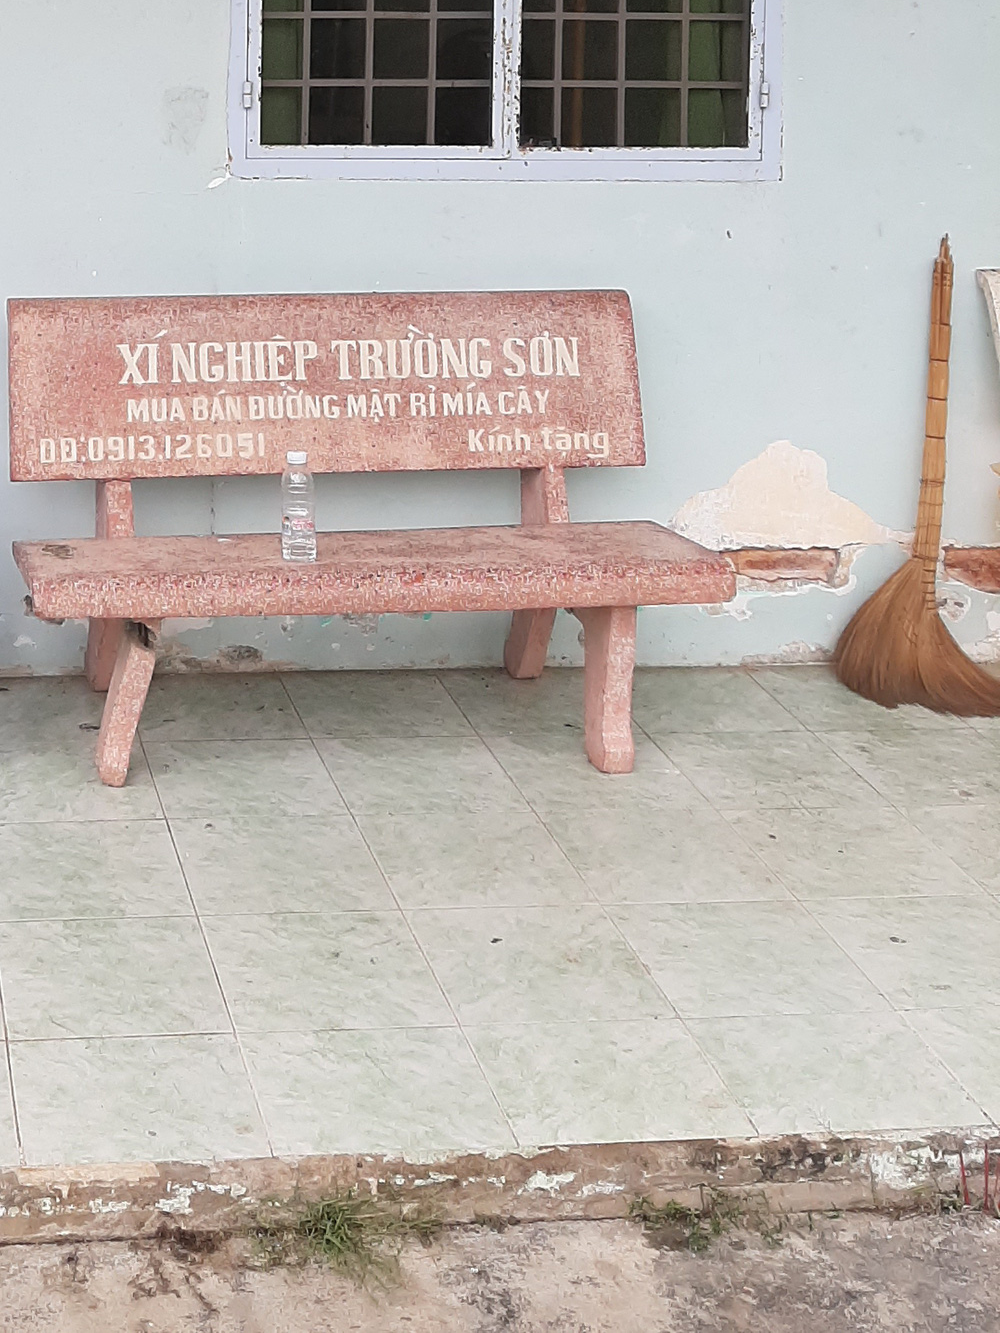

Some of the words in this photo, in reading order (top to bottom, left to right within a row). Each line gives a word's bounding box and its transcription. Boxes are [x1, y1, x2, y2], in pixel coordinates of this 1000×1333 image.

[115, 329, 168, 385] XÍ
[331, 323, 493, 380] TRƯỜNG
[503, 330, 581, 378] SƠN
[126, 397, 186, 423] MUA
[193, 389, 242, 423] BÁN
[249, 385, 340, 420] ĐƯỜNG
[347, 388, 401, 423] MẬT
[410, 384, 436, 417] RỈ
[443, 382, 493, 416] MÍA
[468, 426, 531, 452] Kính
[541, 426, 610, 459] tặng
